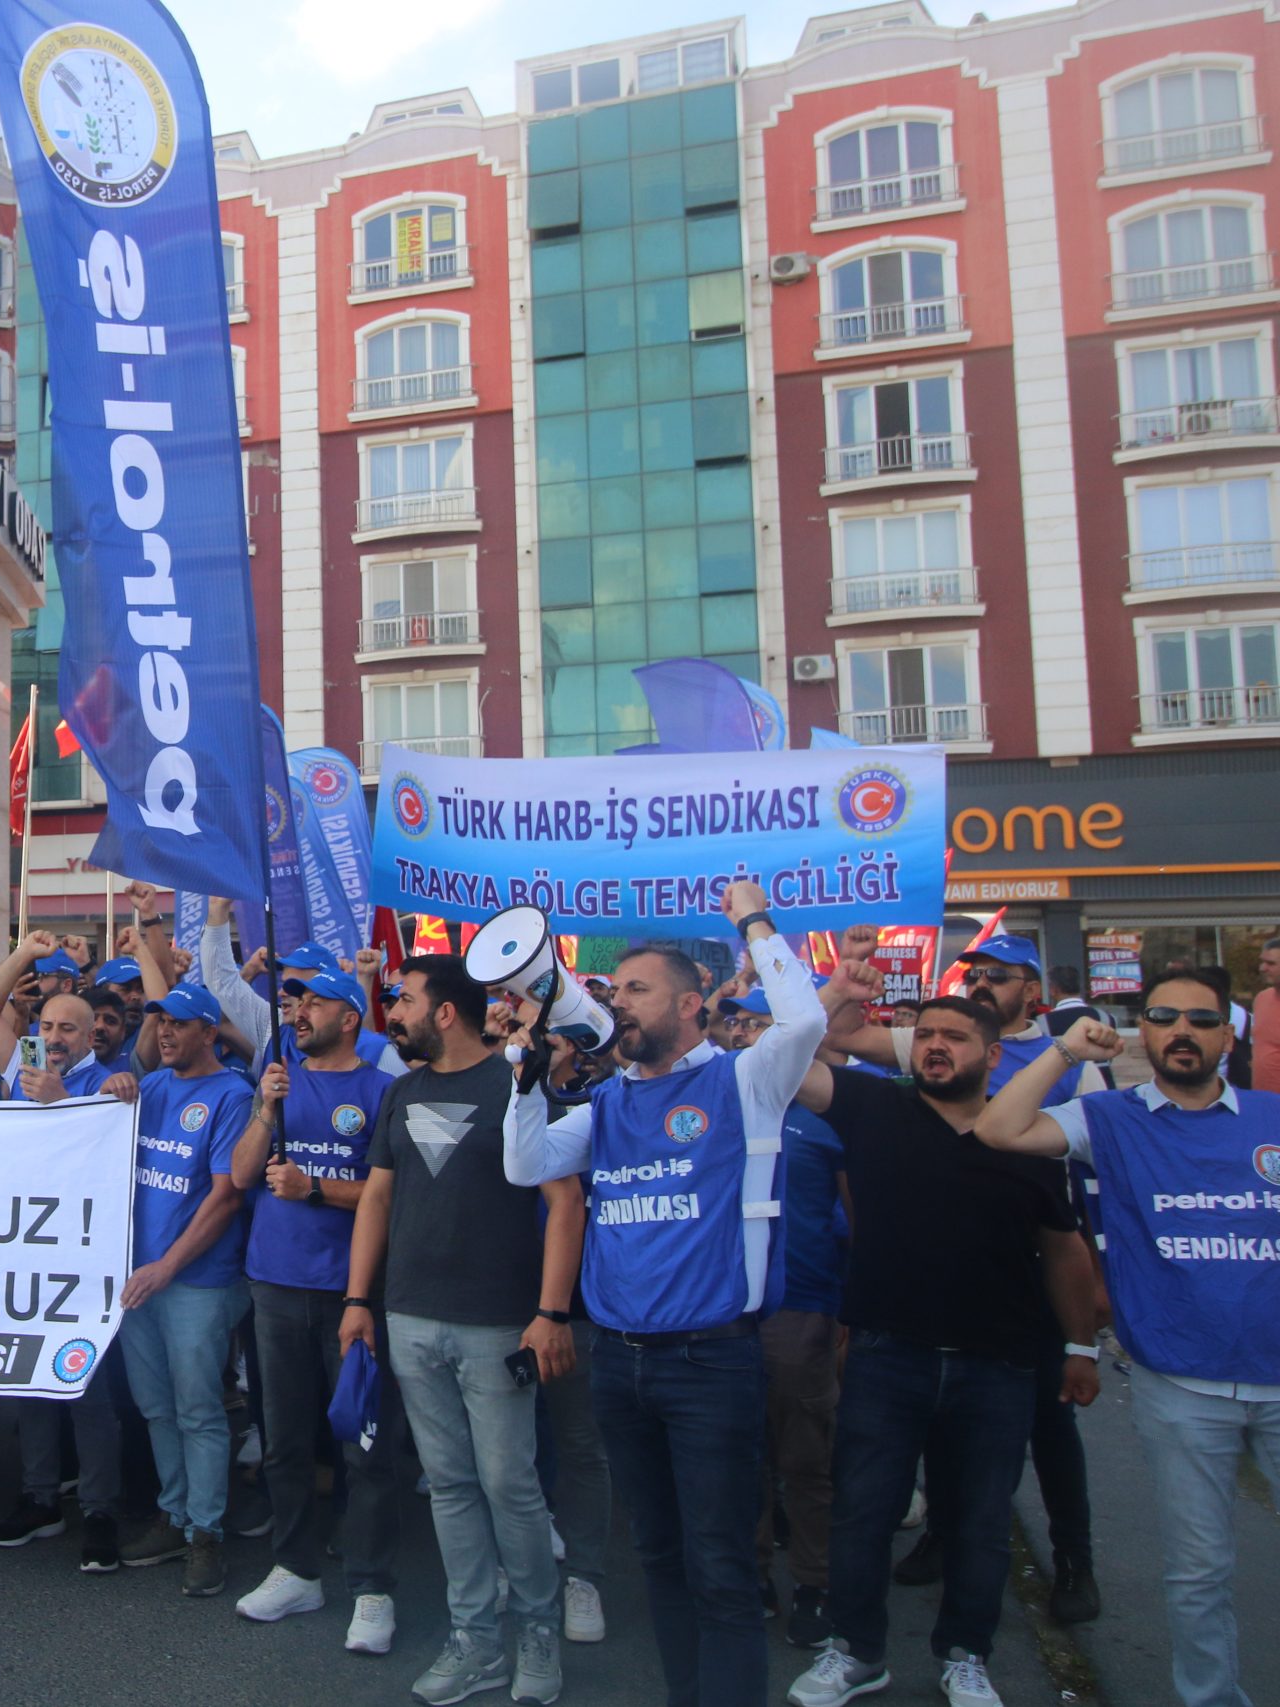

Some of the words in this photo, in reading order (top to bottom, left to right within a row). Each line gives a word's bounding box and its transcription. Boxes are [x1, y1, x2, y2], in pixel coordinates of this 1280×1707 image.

[438, 788, 506, 841] TÜRK
[514, 787, 638, 849] HARB-İŞ
[647, 780, 820, 840] SENDİKASI
[952, 802, 1123, 852] ome
[395, 857, 502, 910] TRAKYA
[509, 869, 620, 917] BÖLGE
[981, 881, 1059, 899] EDİYORUZ
[884, 974, 919, 990] SAAT
[137, 1136, 192, 1158] etrol-iş
[135, 1167, 189, 1194] NDİKASI
[592, 1158, 693, 1185] petrol-iş
[81, 1198, 93, 1246] !
[1156, 1233, 1280, 1261] SENDİKA
[100, 1276, 114, 1324] !
